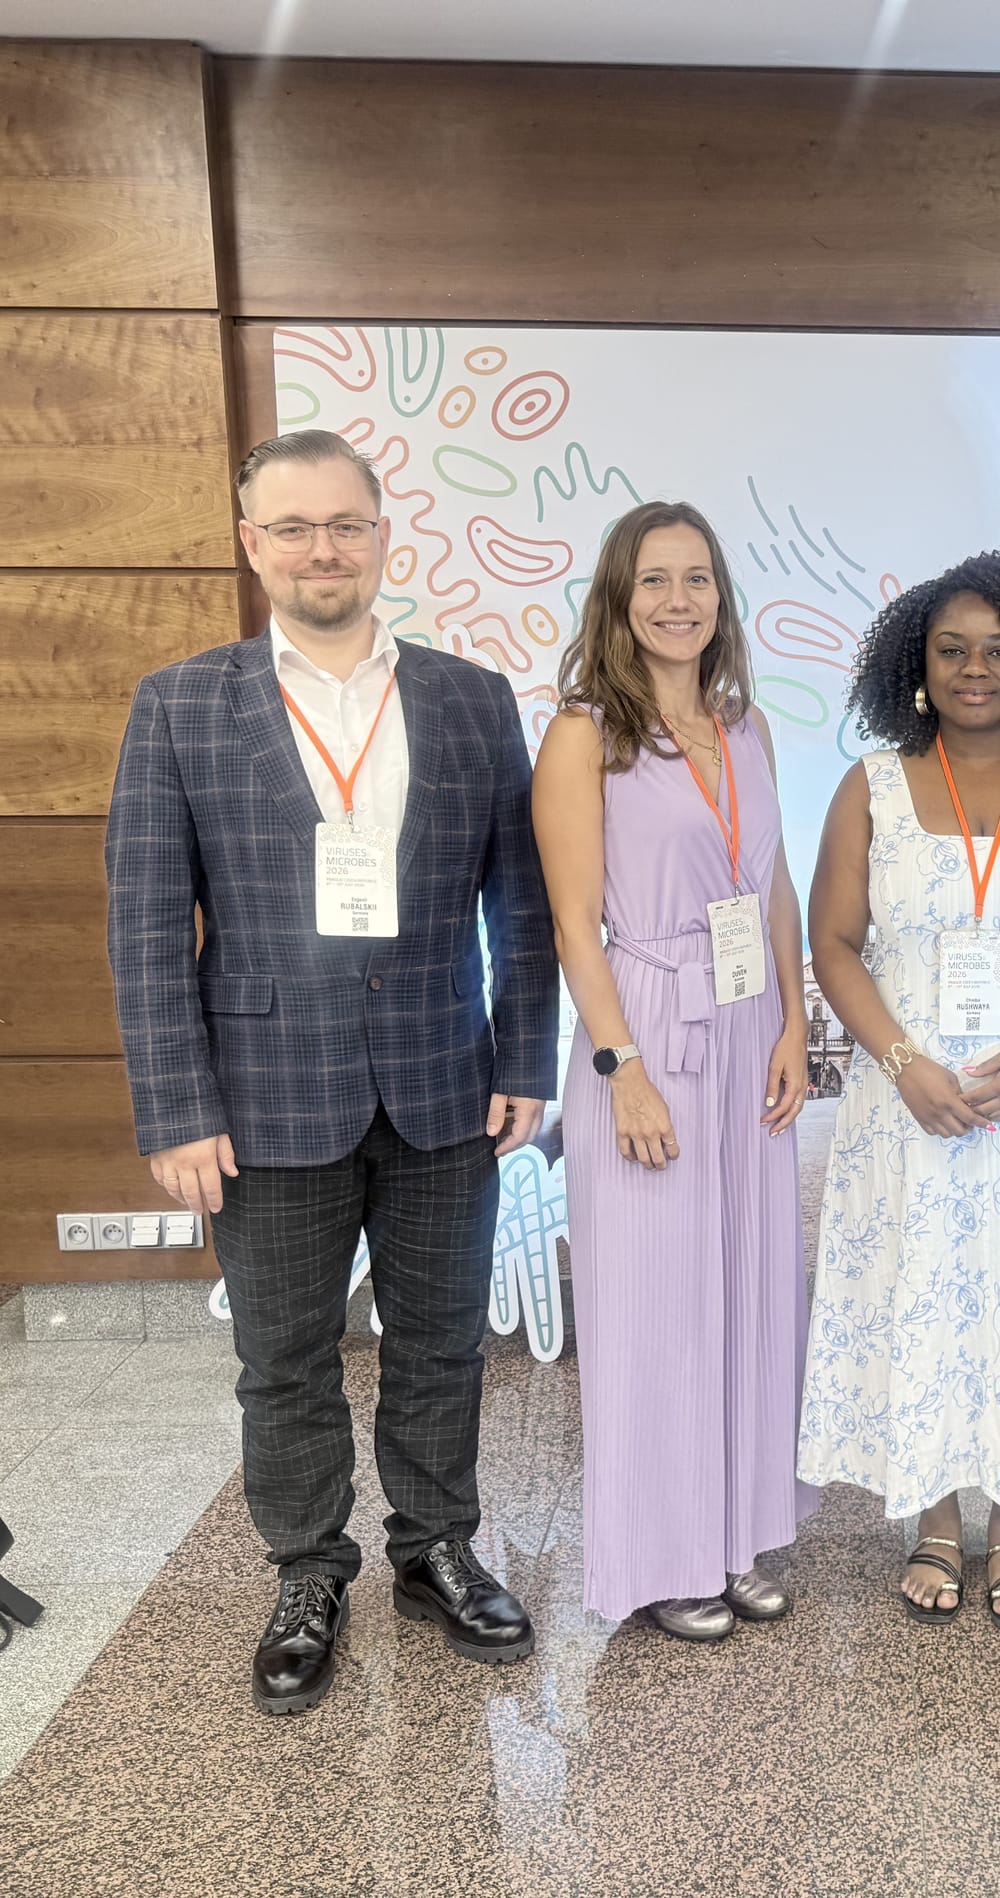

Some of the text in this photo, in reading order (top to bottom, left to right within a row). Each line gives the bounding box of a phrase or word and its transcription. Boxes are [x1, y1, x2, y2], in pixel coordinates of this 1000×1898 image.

[326, 847, 367, 857] VIRUSES
[326, 857, 377, 868] MICROBES
[717, 918, 744, 930] VIRUSES
[718, 925, 751, 939] MICROBES
[948, 952, 982, 961] VIRUSES
[948, 961, 991, 970] MICROBES
